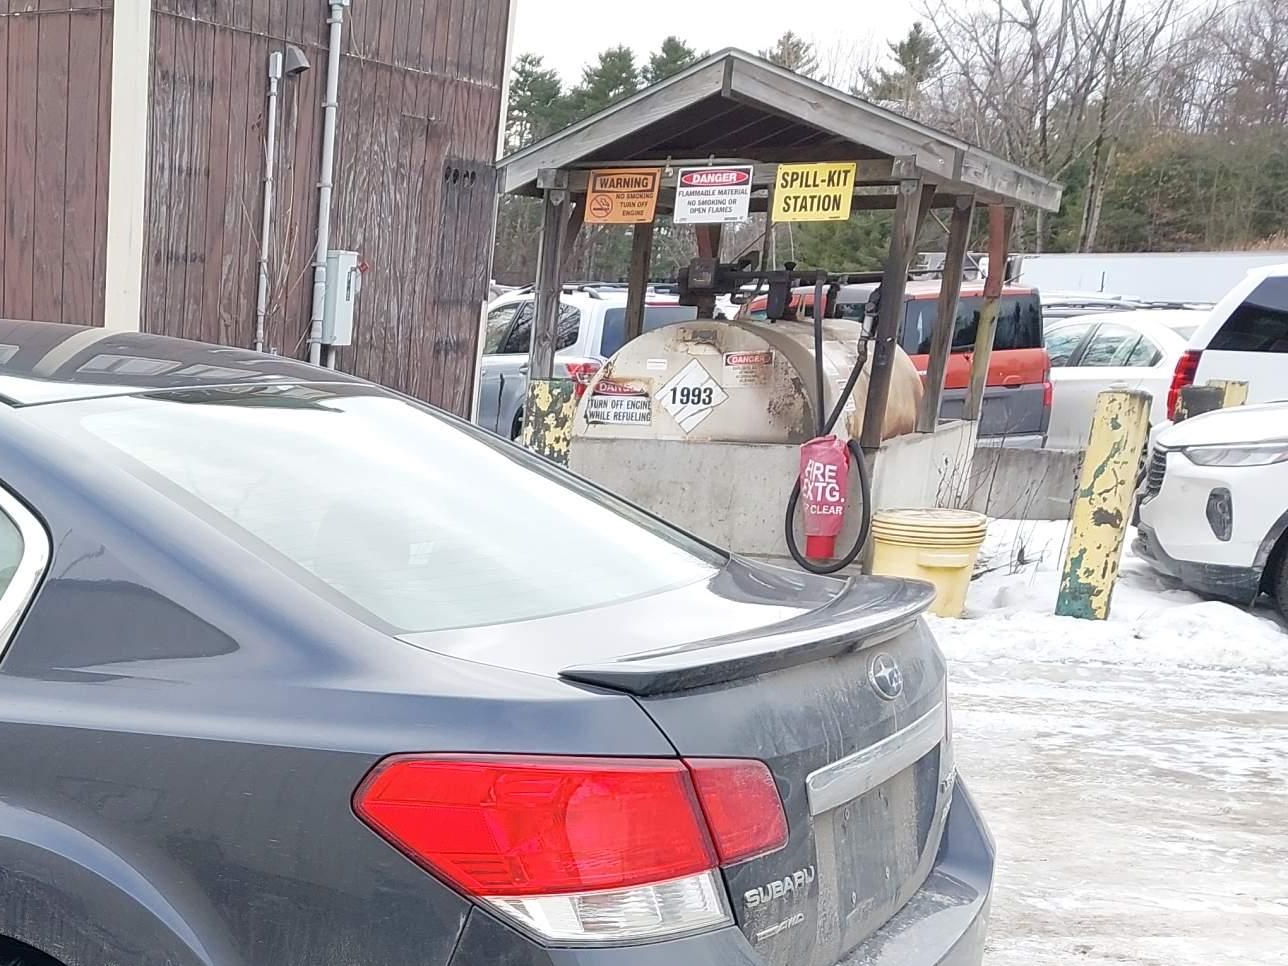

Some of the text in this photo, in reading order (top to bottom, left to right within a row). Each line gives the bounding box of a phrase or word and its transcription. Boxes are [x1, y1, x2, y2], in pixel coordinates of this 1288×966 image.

[599, 176, 649, 188] WARNING
[692, 173, 737, 183] DANGER
[781, 169, 851, 189] SPILL-KIT
[782, 194, 842, 213] STATION
[670, 386, 714, 406] 1993
[590, 399, 651, 411] TURN OFF ENGINE
[588, 410, 651, 422] WHILE REFUELING
[810, 504, 843, 515] CLEAR
[744, 864, 815, 908] SUBARU
